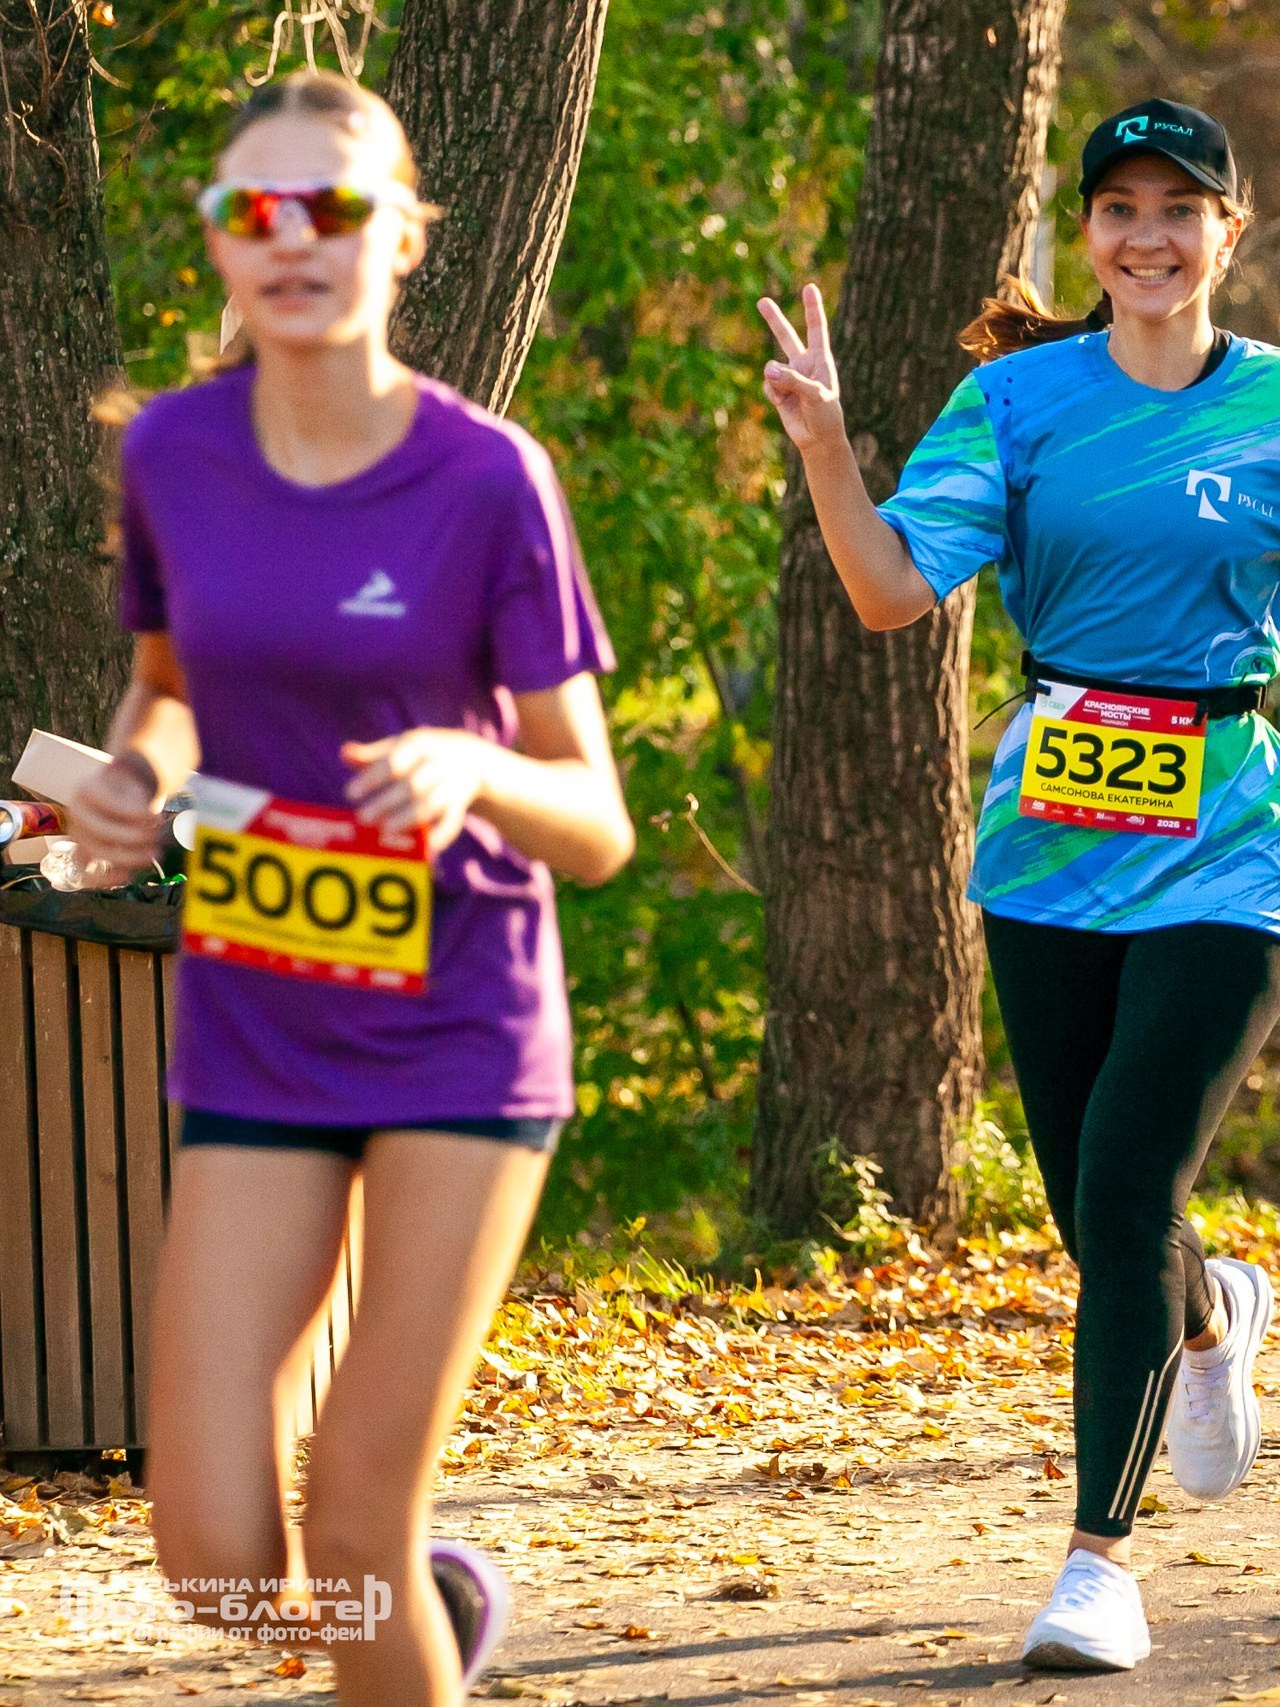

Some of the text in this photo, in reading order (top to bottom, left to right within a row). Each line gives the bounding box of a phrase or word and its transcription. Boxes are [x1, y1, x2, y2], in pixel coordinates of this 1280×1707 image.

[1153, 121, 1194, 137] РУСАЛ
[1084, 699, 1150, 716] КРАСНОЯРСКИЕ
[1100, 710, 1131, 721] МОСТЫ
[1171, 716, 1177, 724] 5
[1035, 726, 1186, 795] 5323
[1040, 782, 1174, 809] САМСОНОВА ЕКАТЕРИНА
[197, 839, 418, 938] 5009
